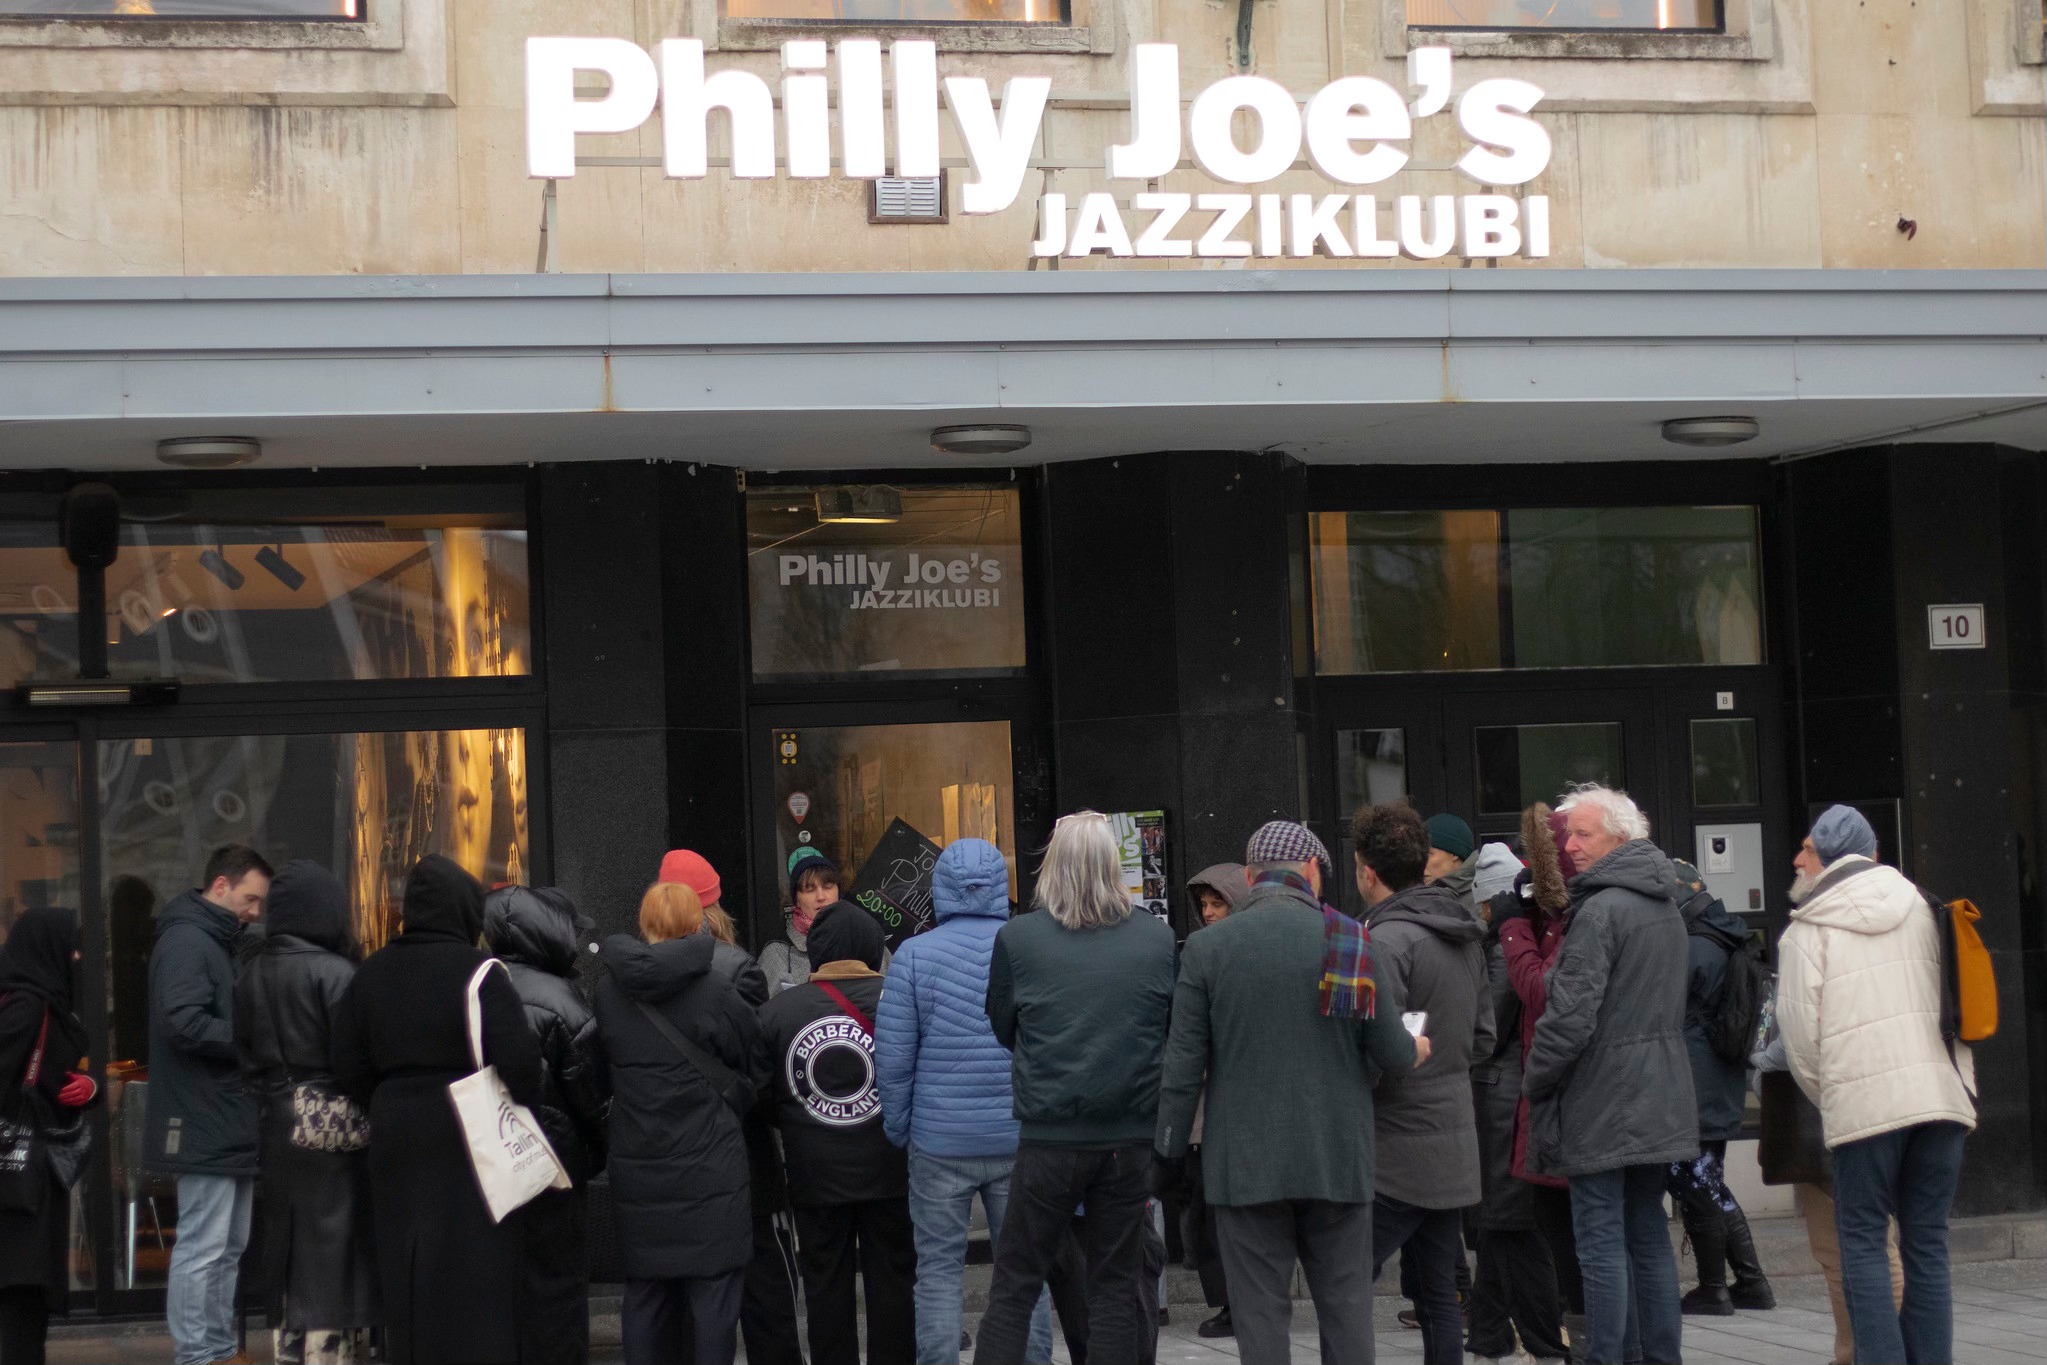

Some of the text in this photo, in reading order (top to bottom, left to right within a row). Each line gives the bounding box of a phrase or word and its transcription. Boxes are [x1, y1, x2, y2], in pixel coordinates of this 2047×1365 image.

[525, 36, 1552, 214] Philly Joe's
[1032, 193, 1550, 259] JAZZIKLUBI
[779, 553, 1001, 591] Philly Joe's
[850, 588, 1000, 610] JAZZIKLUBI
[1942, 615, 1970, 638] 10
[1722, 696, 1729, 705] B
[914, 843, 937, 875] Jo
[856, 889, 902, 927] 20:00
[881, 858, 934, 935] Philly
[796, 1024, 876, 1060] BURBERRY
[806, 1088, 880, 1118] ENGLAND
[503, 1133, 539, 1158] Tallin
